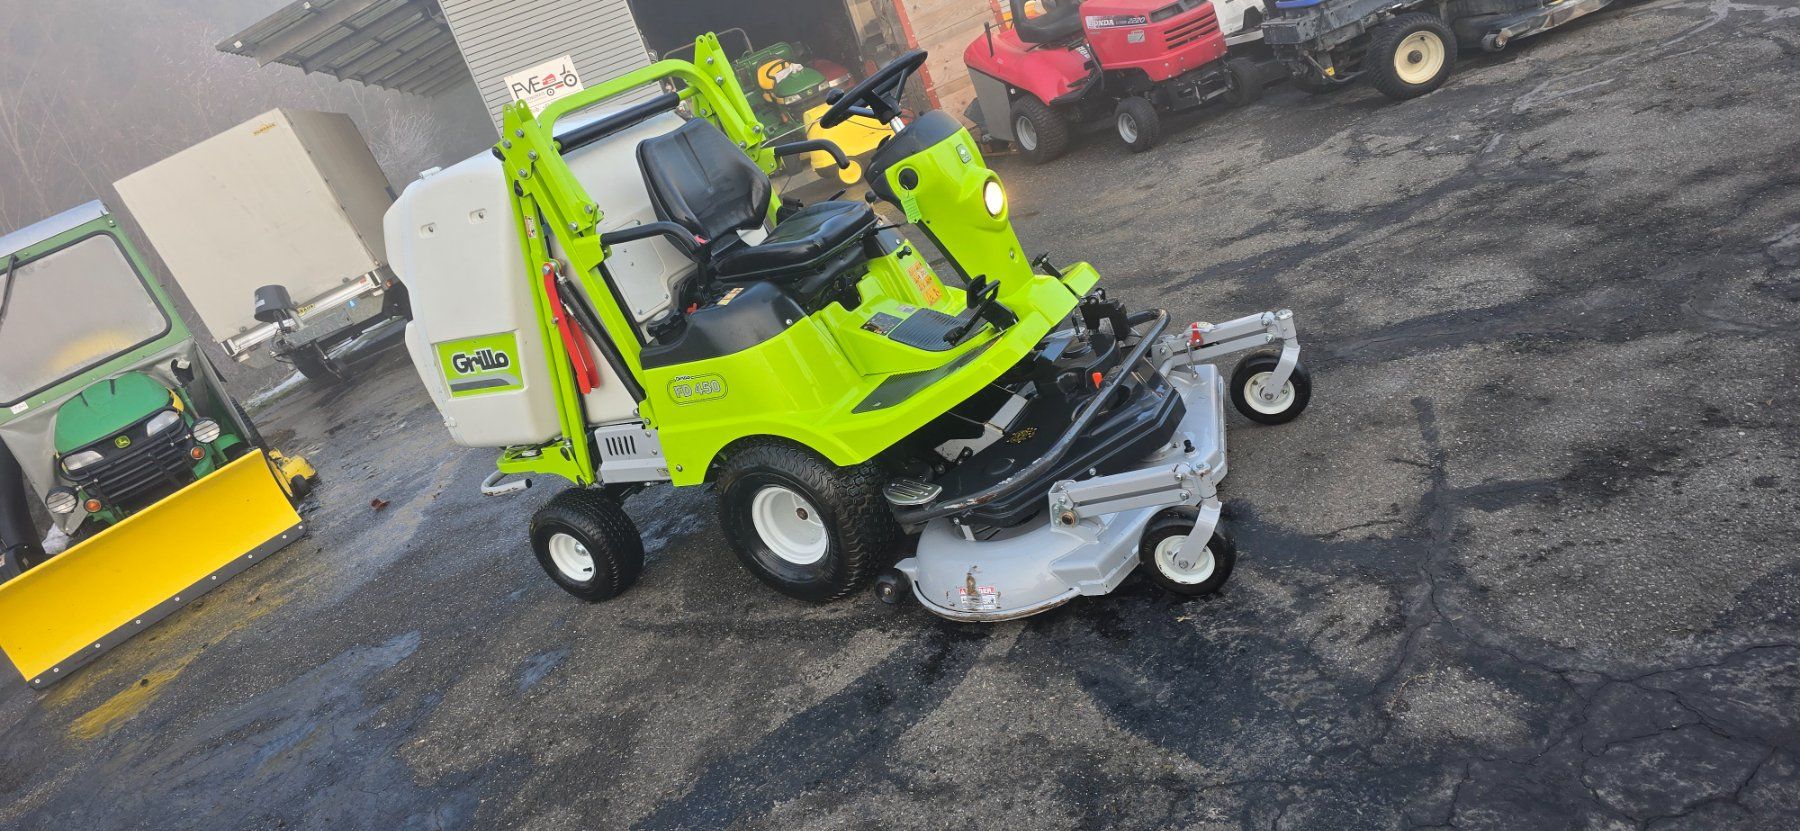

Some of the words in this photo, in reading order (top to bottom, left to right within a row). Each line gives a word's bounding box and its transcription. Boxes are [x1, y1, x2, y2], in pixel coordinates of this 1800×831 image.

[1127, 16, 1146, 25] 2220
[511, 75, 541, 99] FVE
[452, 349, 509, 374] Grillo
[673, 383, 693, 398] FD
[694, 379, 721, 395] 450
